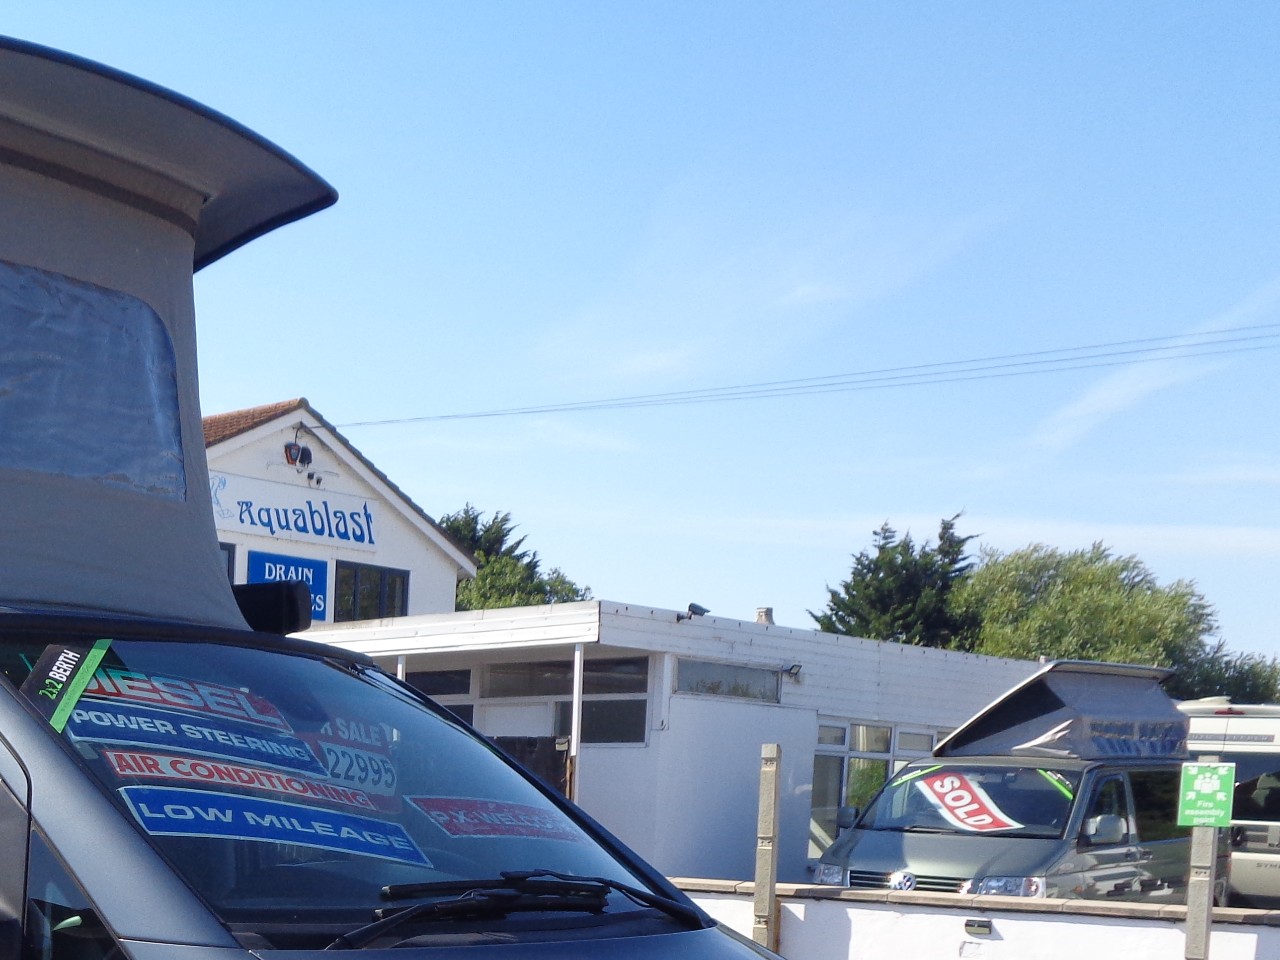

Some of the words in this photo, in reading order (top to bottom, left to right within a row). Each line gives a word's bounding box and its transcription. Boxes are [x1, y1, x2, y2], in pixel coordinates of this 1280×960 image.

[237, 500, 375, 545] Aquablast
[264, 562, 313, 585] DRAIN
[48, 649, 80, 682] BERTH
[72, 709, 177, 735] POWER
[180, 724, 310, 761] STEERING
[113, 753, 162, 775] AIR
[170, 760, 370, 805] CONDITIONING
[326, 747, 396, 788] 22995
[933, 775, 994, 825] SOLD
[139, 803, 232, 823] LOW
[243, 811, 414, 850] MILEAGE
